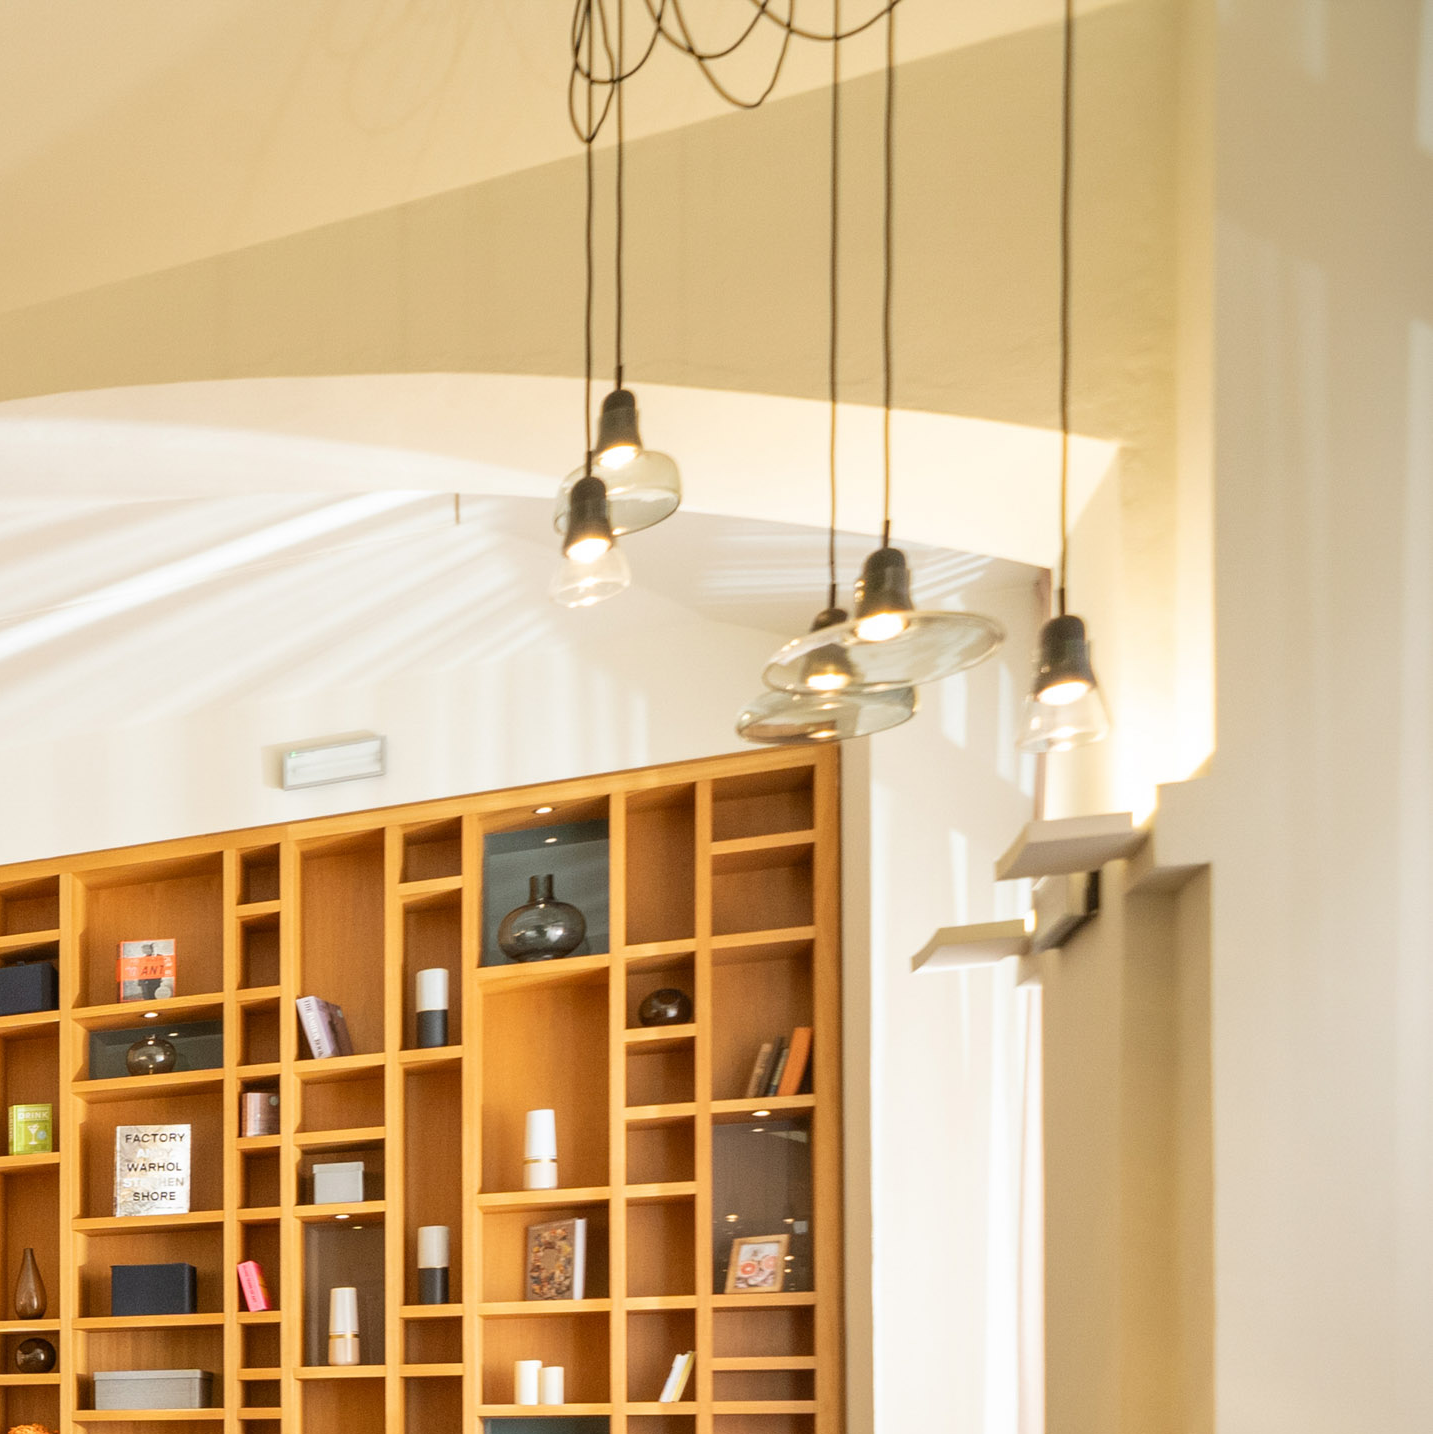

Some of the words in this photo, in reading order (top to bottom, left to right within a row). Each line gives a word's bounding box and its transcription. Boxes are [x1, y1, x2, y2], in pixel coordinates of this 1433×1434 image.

[125, 1133, 185, 1143] FACTORY
[127, 1162, 182, 1172] WARHOL
[133, 1191, 176, 1201] SHORE
